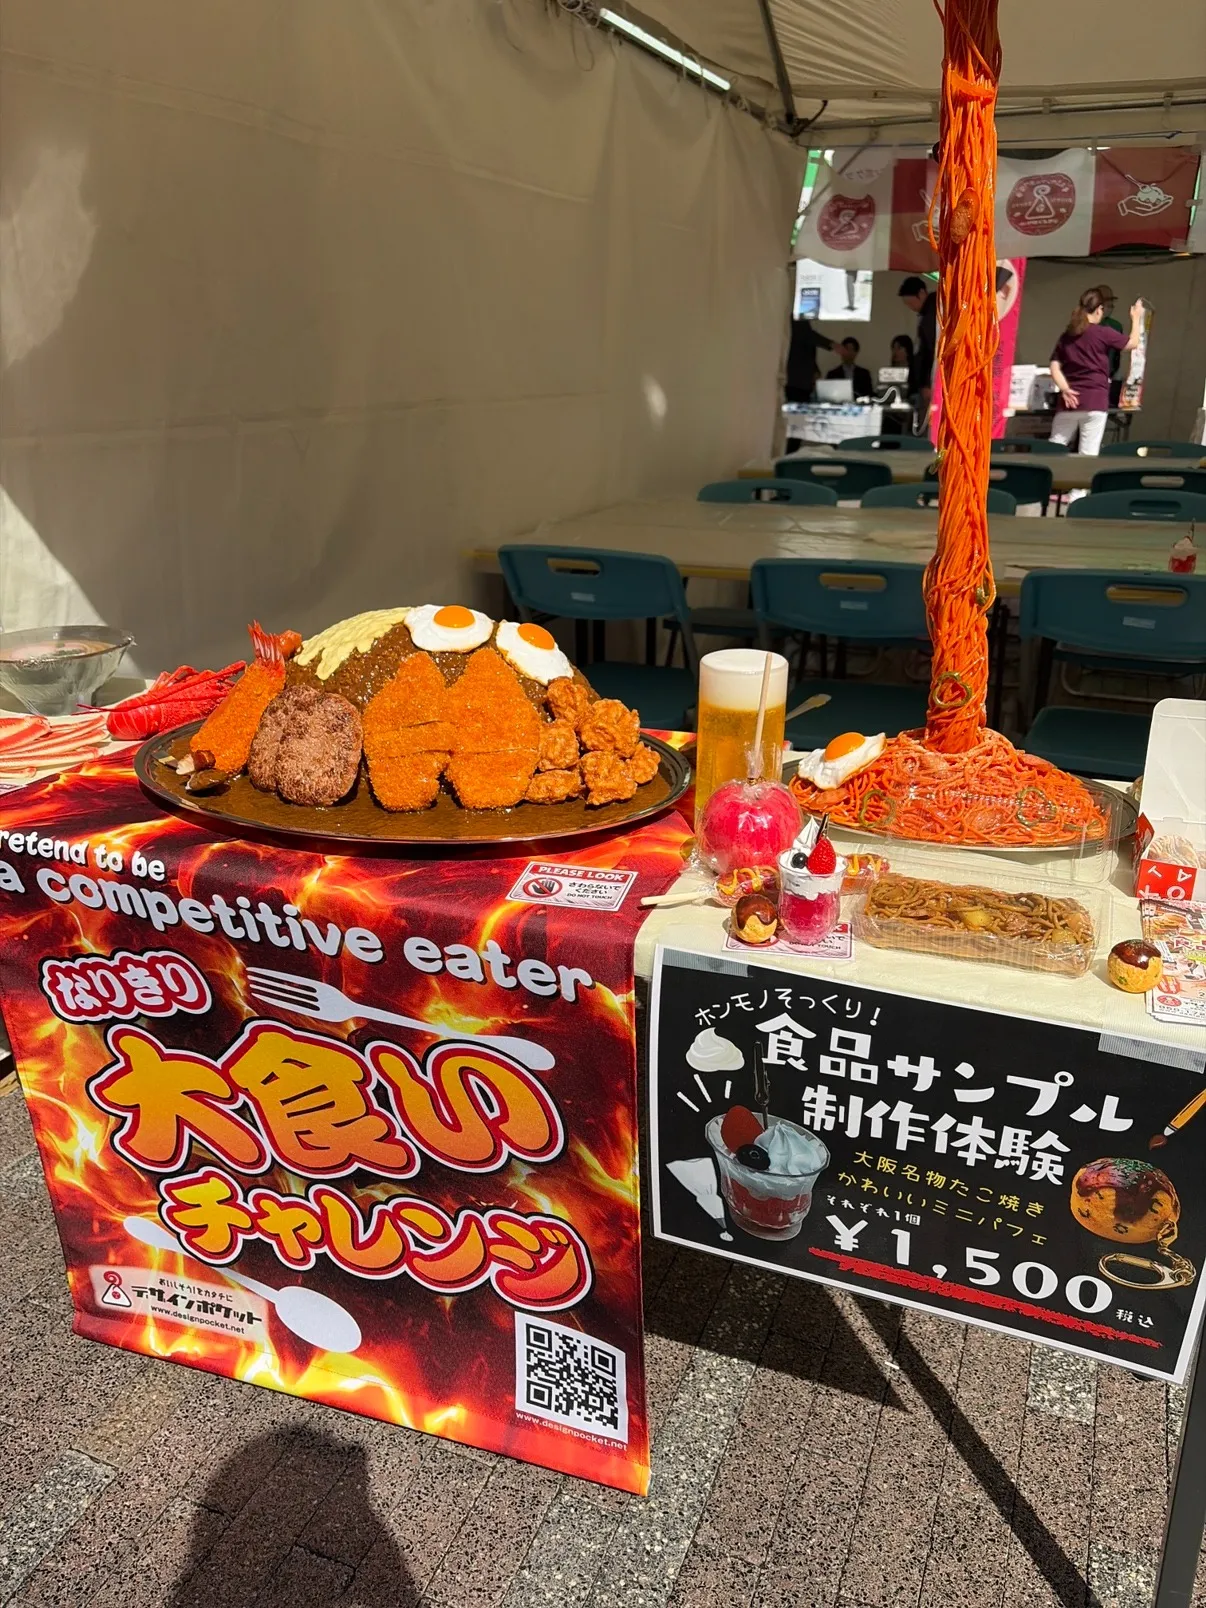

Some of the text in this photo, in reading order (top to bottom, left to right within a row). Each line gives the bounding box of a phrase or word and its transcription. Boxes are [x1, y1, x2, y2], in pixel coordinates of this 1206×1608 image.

[94, 845, 123, 872] to
[131, 851, 165, 880] be
[538, 866, 624, 881] PLEASE LOOK
[568, 881, 621, 891] さわらないで
[0, 860, 592, 1001] a competitive eater
[49, 956, 204, 1014] なりきり
[95, 1025, 558, 1174] 大食い
[755, 1012, 1133, 1132] 食品サンプル
[801, 1085, 1071, 1185] 制作体験
[826, 1195, 921, 1226] それぞれ1個
[837, 1171, 1048, 1246] かわいいミニパフェ
[853, 1150, 1046, 1217] 大阪名物たこ焼き
[168, 1172, 586, 1305] チャレンジ
[150, 1305, 245, 1334] www.designpocket.net
[1115, 1308, 1155, 1328] 税込
[515, 1411, 628, 1452] www.designpocket.net
